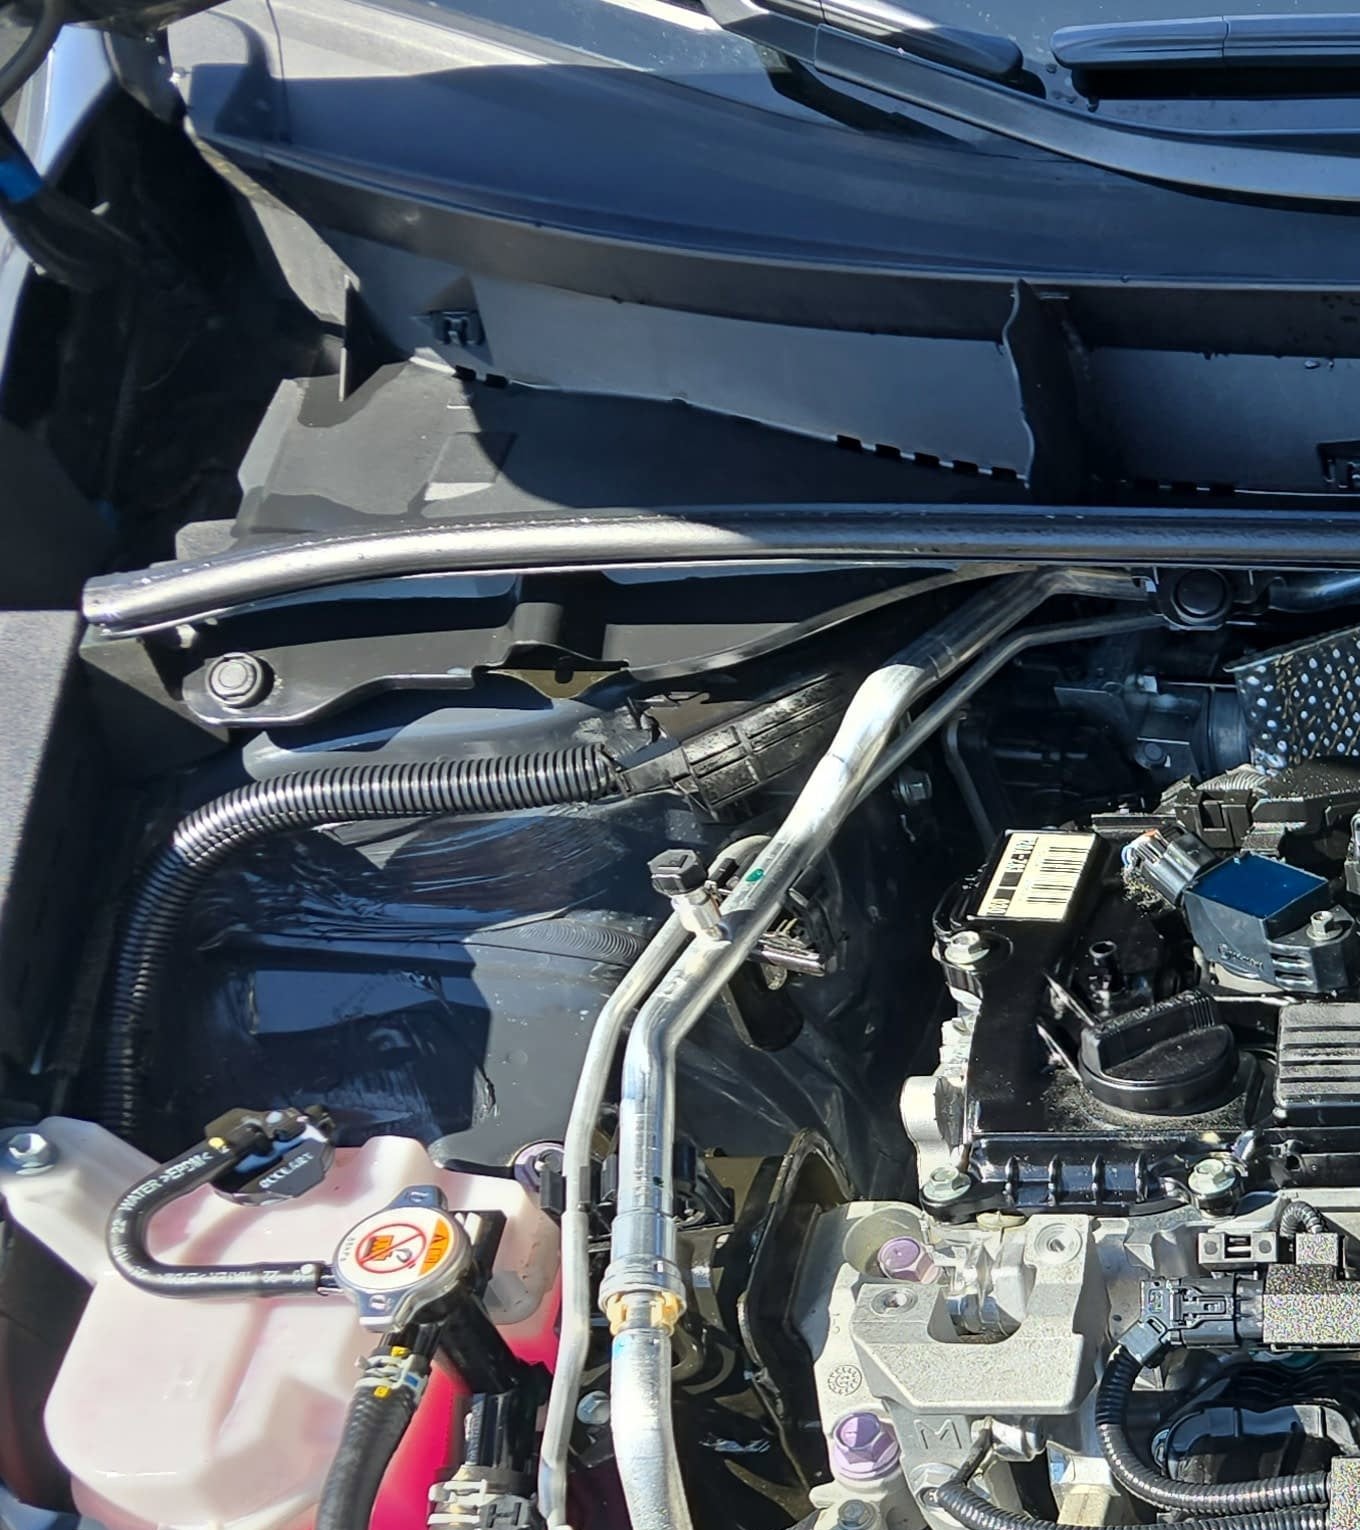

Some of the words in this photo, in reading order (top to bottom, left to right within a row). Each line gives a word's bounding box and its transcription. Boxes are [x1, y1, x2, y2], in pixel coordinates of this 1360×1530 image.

[119, 1178, 163, 1212] WATER
[913, 1419, 963, 1450] M
[486, 1502, 522, 1529] H
